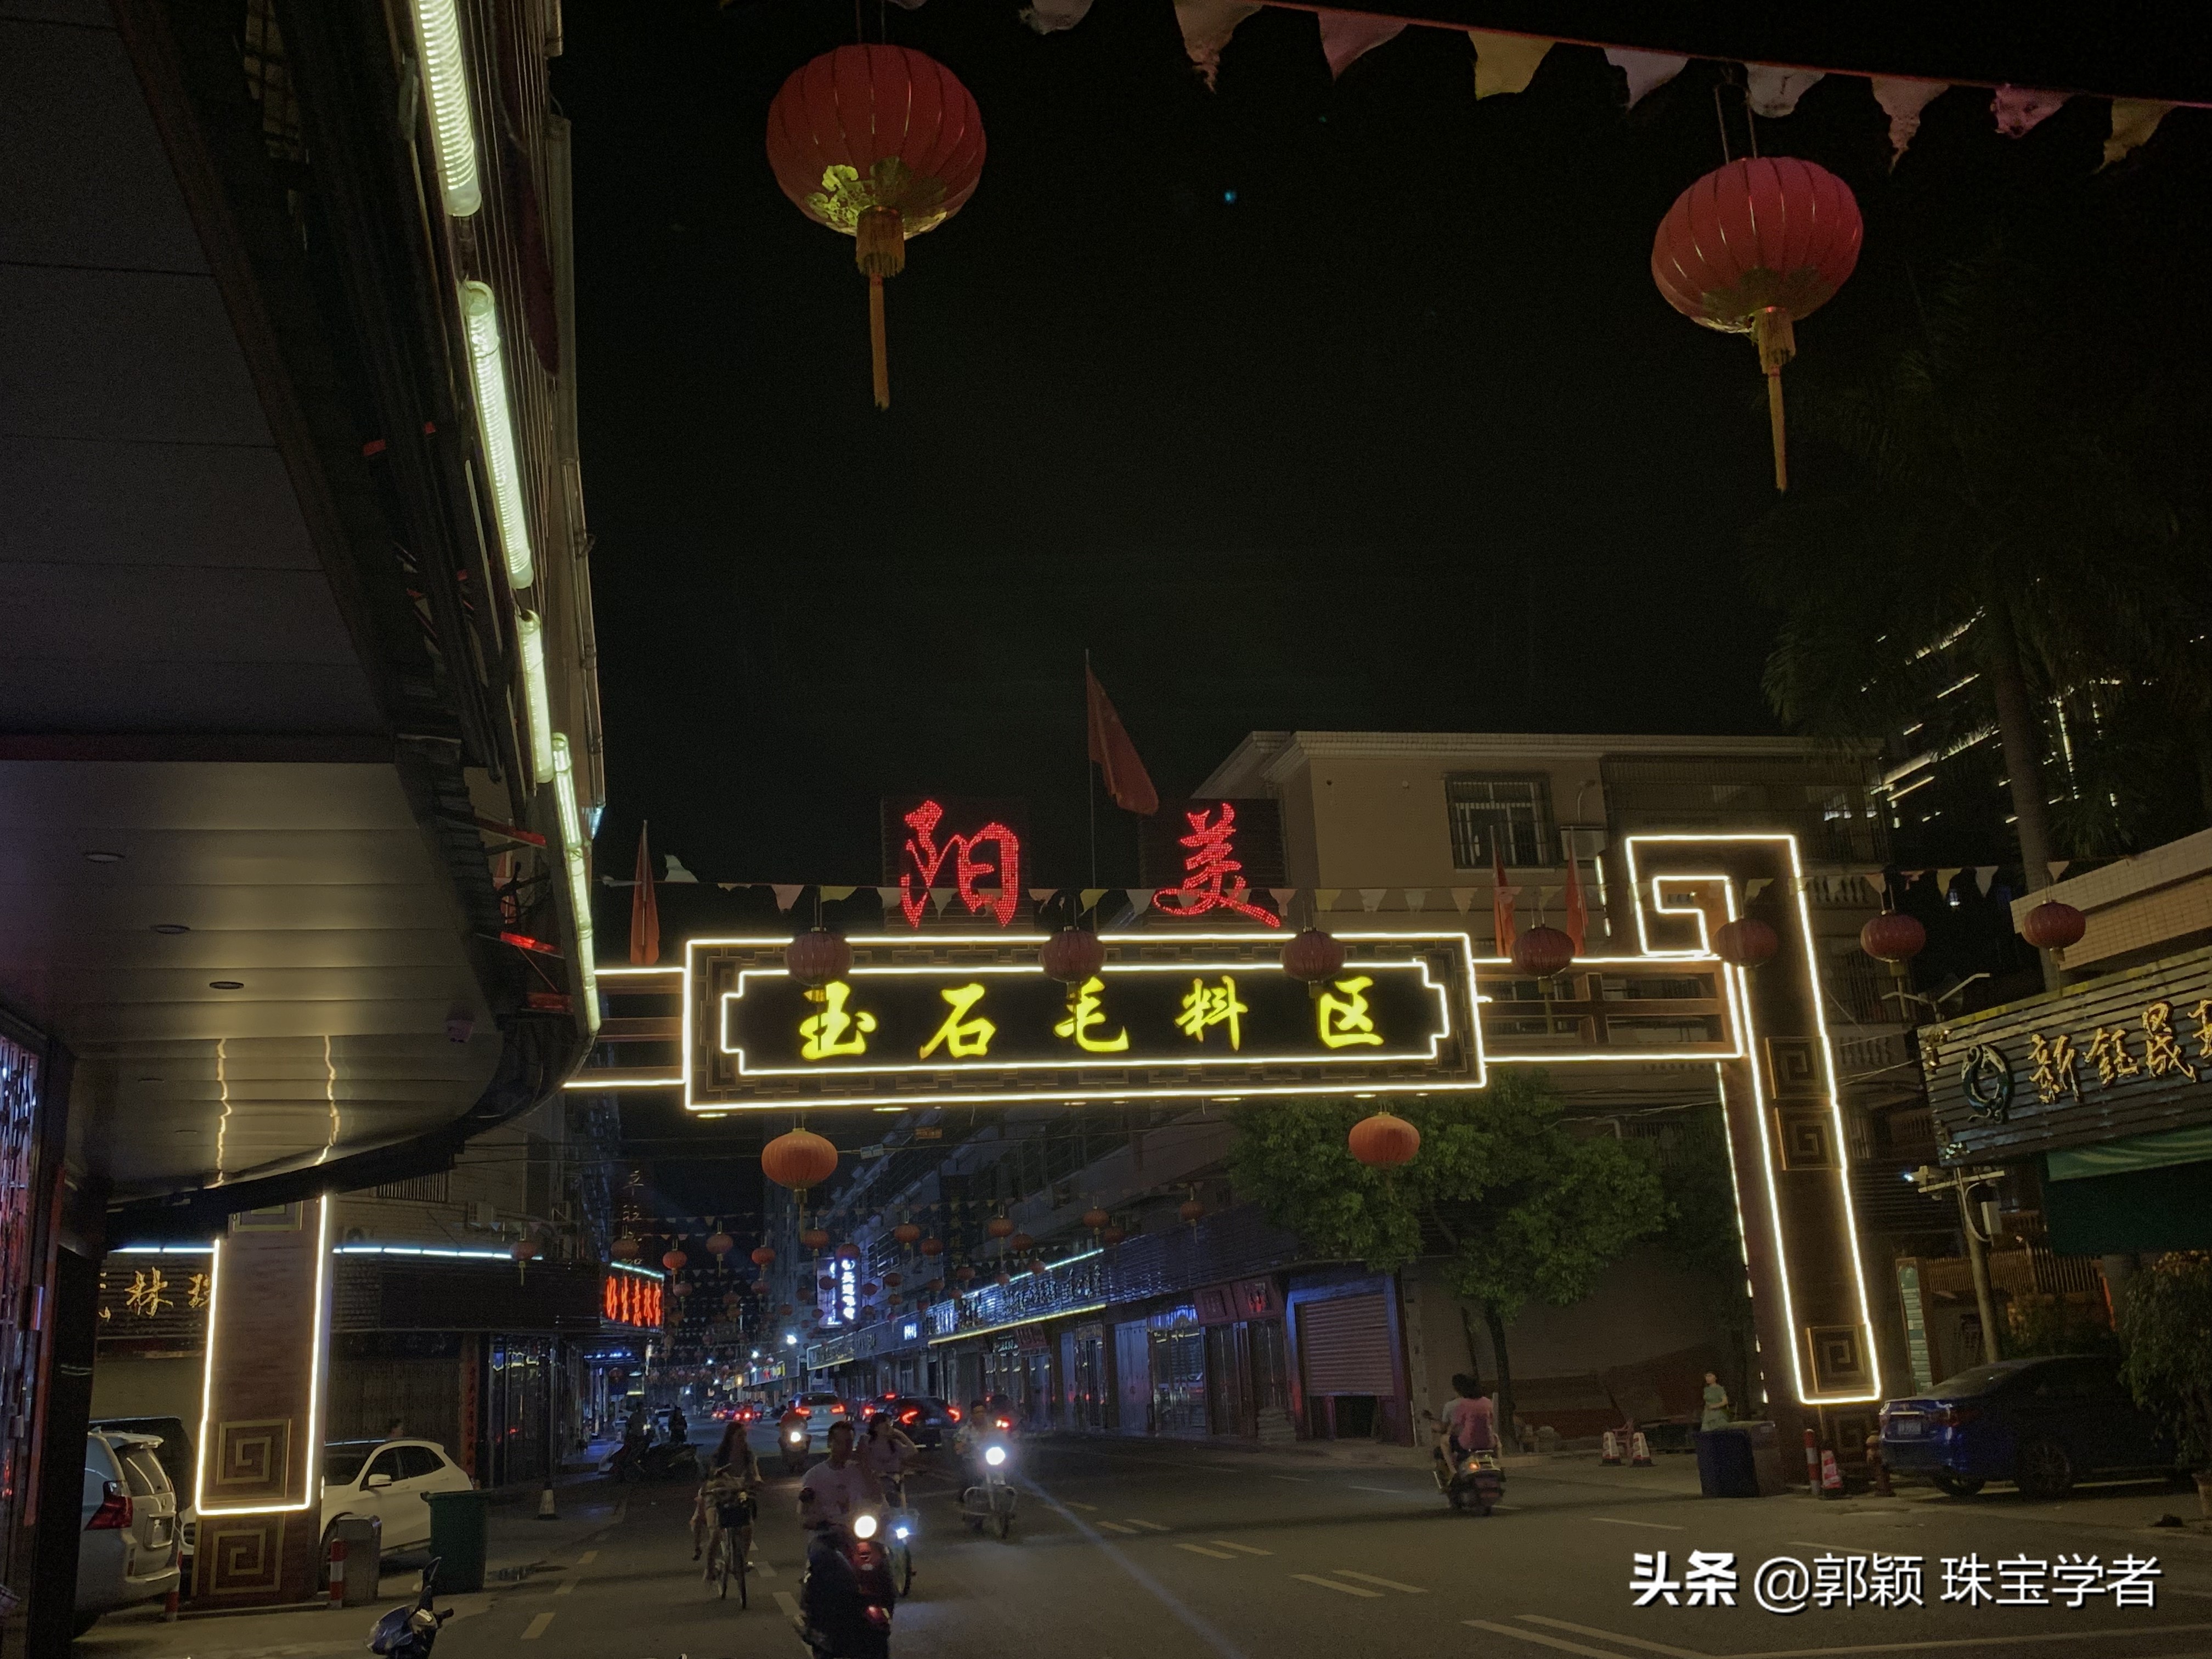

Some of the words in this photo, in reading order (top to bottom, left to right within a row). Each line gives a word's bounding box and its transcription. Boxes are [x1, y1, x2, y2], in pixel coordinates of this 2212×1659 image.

[799, 976, 1385, 1062] 玉石毛料区
